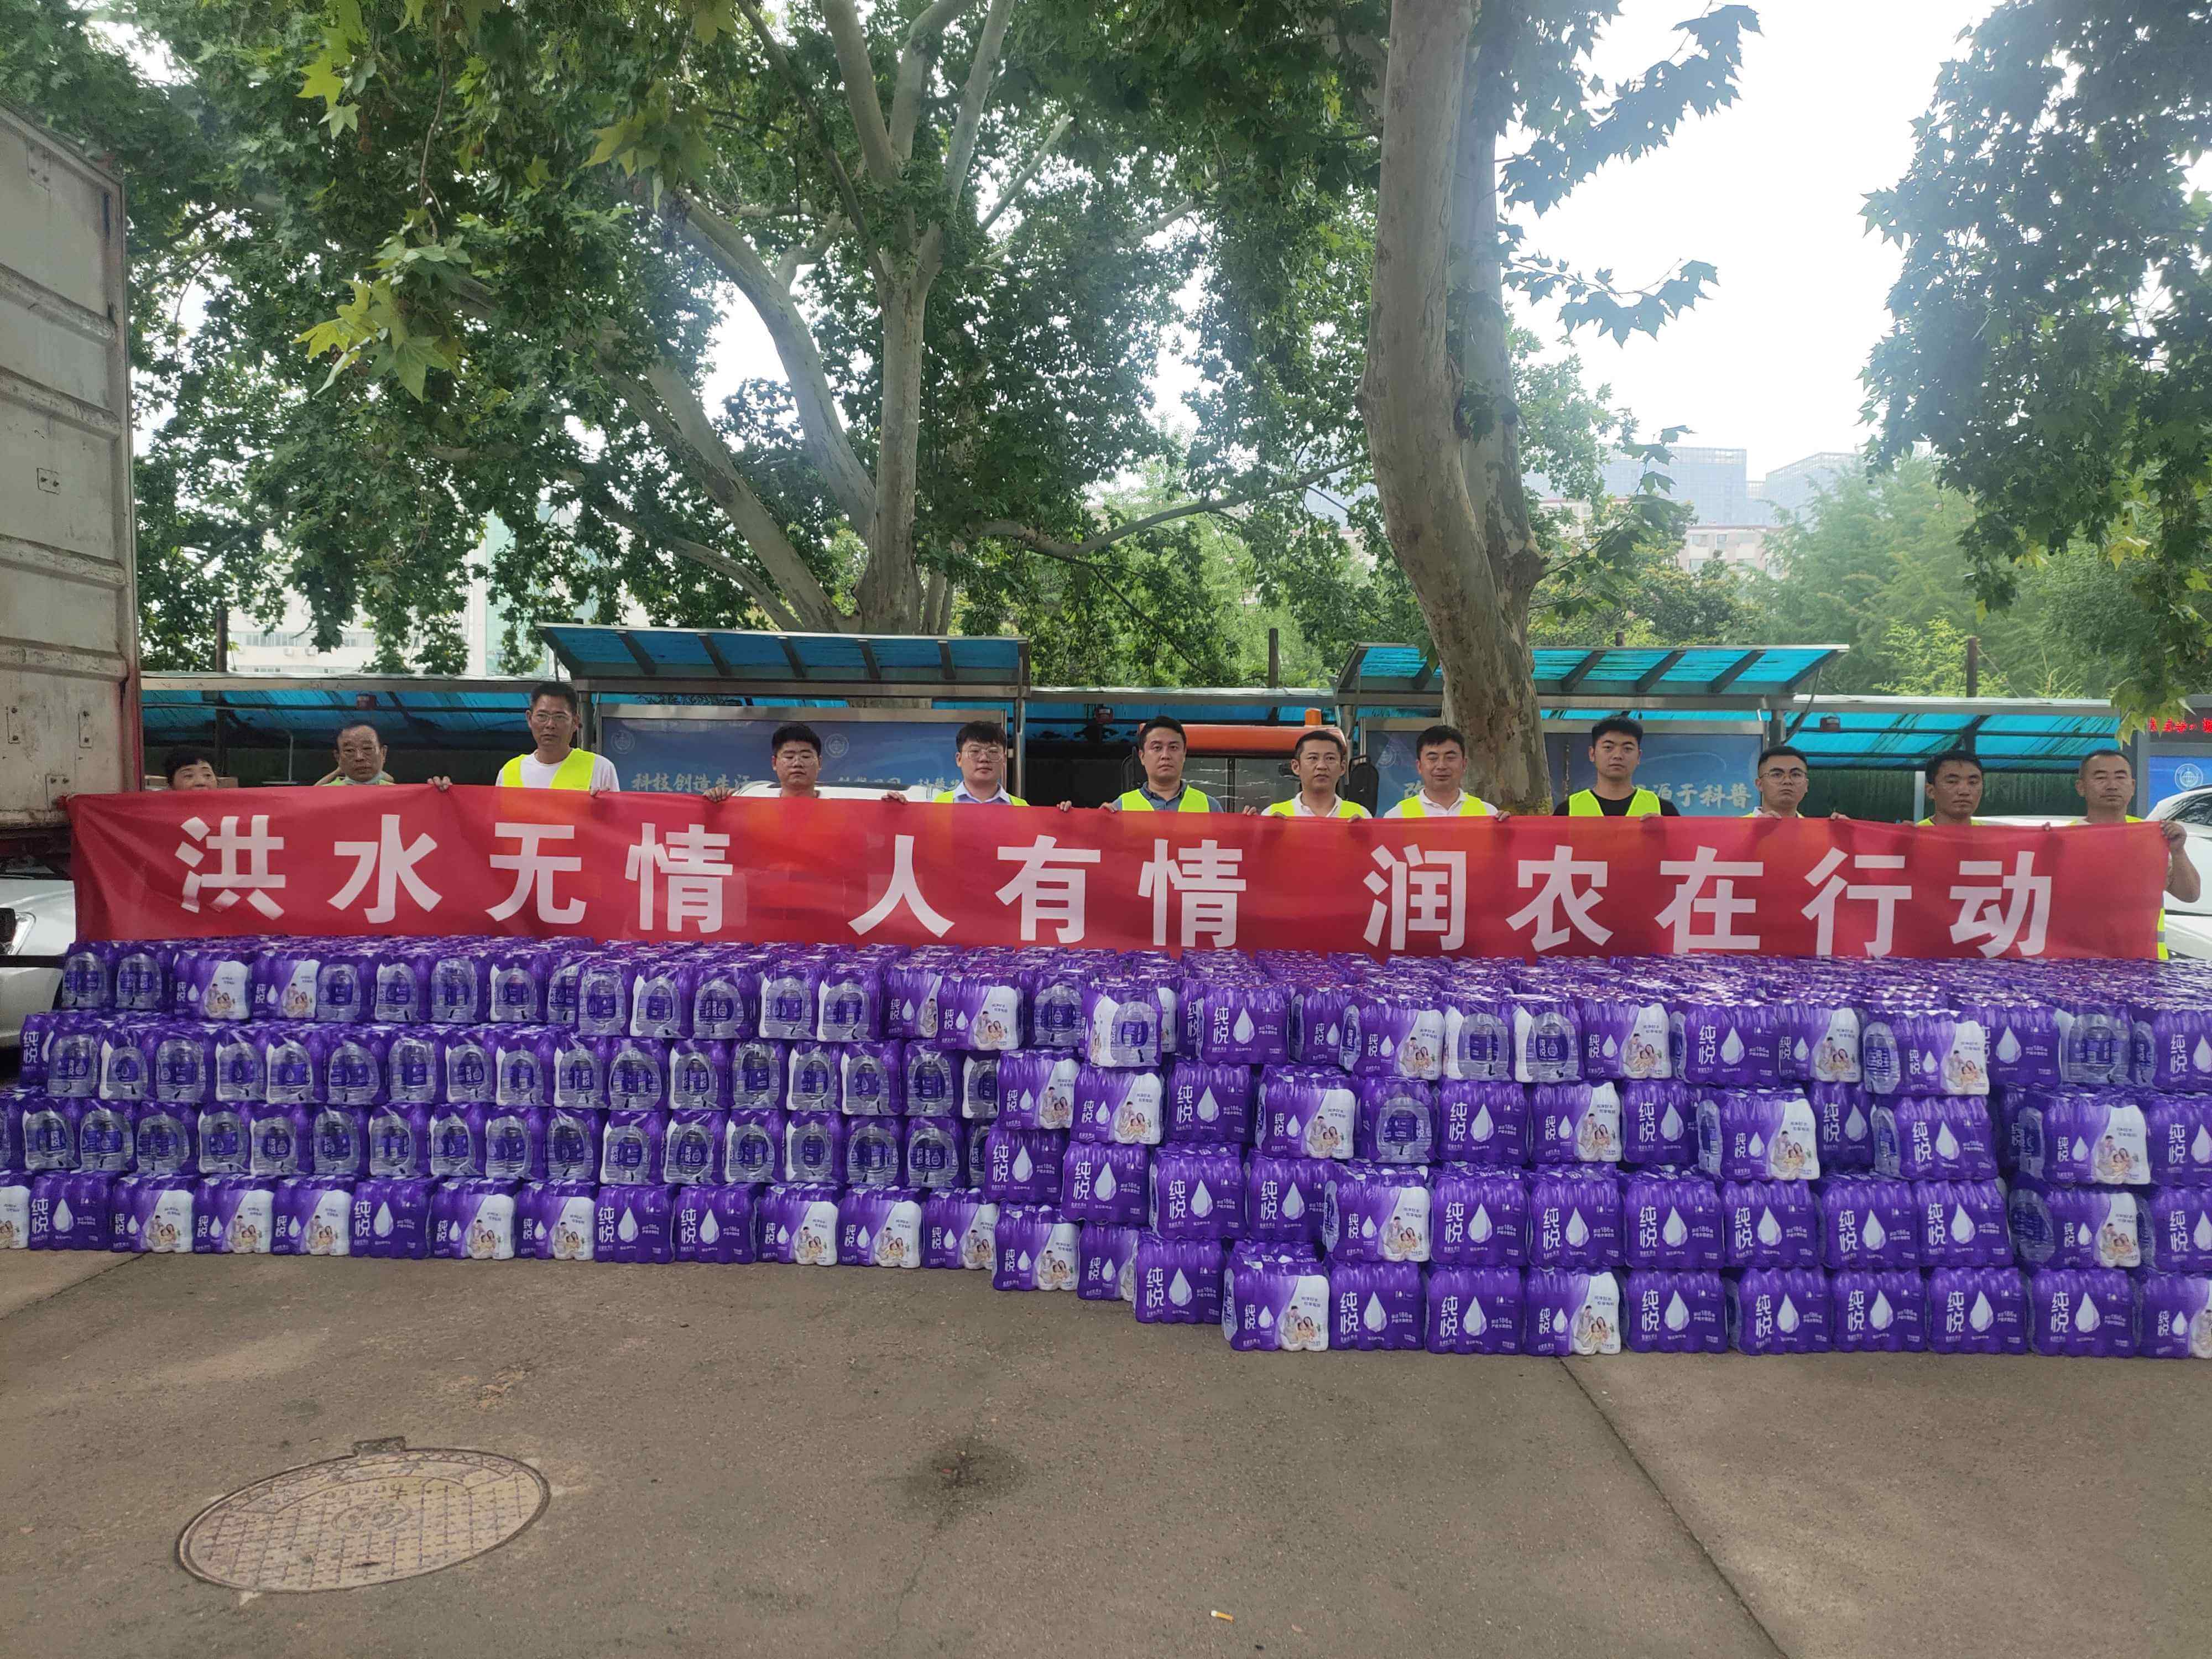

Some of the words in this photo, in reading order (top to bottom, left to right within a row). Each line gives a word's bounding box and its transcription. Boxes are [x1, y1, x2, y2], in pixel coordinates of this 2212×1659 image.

[176, 815, 733, 933] 洪水无情
[848, 835, 1246, 947] 人有情
[1364, 844, 2051, 959] 润农在行动
[177, 982, 188, 1001] 纯悦
[255, 984, 267, 1003] 纯悦
[890, 999, 900, 1020] 纯悦
[944, 1009, 954, 1030] 纯悦
[1213, 1005, 1229, 1044] 纯悦
[1314, 1023, 1324, 1045] 纯悦
[23, 1031, 39, 1063] 纯悦
[1368, 1034, 1378, 1056] 纯悦
[1589, 1034, 1599, 1058] 纯悦
[1699, 1025, 1715, 1064] 纯悦
[1779, 1036, 1791, 1062] 纯悦
[1910, 1050, 1921, 1074] 纯悦
[2171, 1034, 2187, 1073] 纯悦
[1007, 1090, 1018, 1112] 纯悦
[1082, 1100, 1096, 1123] 纯悦
[1177, 1085, 1192, 1123] 纯悦
[1274, 1113, 1284, 1136] 纯悦
[1449, 1102, 1467, 1141] 纯悦
[1546, 1115, 1556, 1140] 纯悦
[1639, 1099, 1656, 1142] 纯悦
[1822, 1102, 1840, 1141] 纯悦
[1735, 1133, 1746, 1158] 纯悦
[1912, 1121, 1932, 1164] 纯悦
[2058, 1137, 2069, 1162] 纯悦
[2169, 1123, 2185, 1164] 纯悦
[993, 1145, 1009, 1182] 纯悦
[1073, 1160, 1091, 1199] 纯悦
[32, 1198, 49, 1234] 纯悦
[1169, 1180, 1186, 1219] 纯悦
[1261, 1180, 1277, 1220] 纯悦
[115, 1214, 124, 1234] 纯悦
[197, 1215, 208, 1237] 纯悦
[275, 1215, 287, 1237] 纯悦
[354, 1199, 371, 1237] 纯悦
[437, 1220, 447, 1241] 纯悦
[523, 1218, 535, 1239] 纯悦
[598, 1206, 614, 1243] 纯悦
[681, 1208, 696, 1243] 纯悦
[765, 1223, 775, 1244] 纯悦
[844, 1224, 857, 1246] 纯悦
[1348, 1213, 1359, 1239] 纯悦
[1446, 1202, 1464, 1243] 纯悦
[1543, 1208, 1560, 1251] 纯悦
[1640, 1206, 1657, 1248] 纯悦
[1735, 1207, 1753, 1251] 纯悦
[1839, 1210, 1858, 1255] 纯悦
[1928, 1203, 1946, 1245] 纯悦
[2064, 1222, 2075, 1247] 纯悦
[2170, 1211, 2189, 1252] 纯悦
[932, 1227, 941, 1249] 纯悦
[1005, 1249, 1015, 1271] 纯悦
[1088, 1258, 1100, 1280] 纯悦
[1146, 1267, 1164, 1308] 纯悦
[1146, 1267, 1164, 1308] 纯悦
[1245, 1305, 1255, 1329] 纯悦
[1340, 1291, 1358, 1336] 纯悦
[1440, 1296, 1458, 1338] 纯悦
[1539, 1308, 1550, 1334] 纯悦
[1642, 1290, 1659, 1331] 纯悦
[1756, 1295, 1772, 1339] 纯悦
[1848, 1290, 1864, 1331] 纯悦
[1947, 1291, 1964, 1333] 纯悦
[2051, 1291, 2069, 1333] 纯悦
[2158, 1311, 2169, 1336] 纯悦
